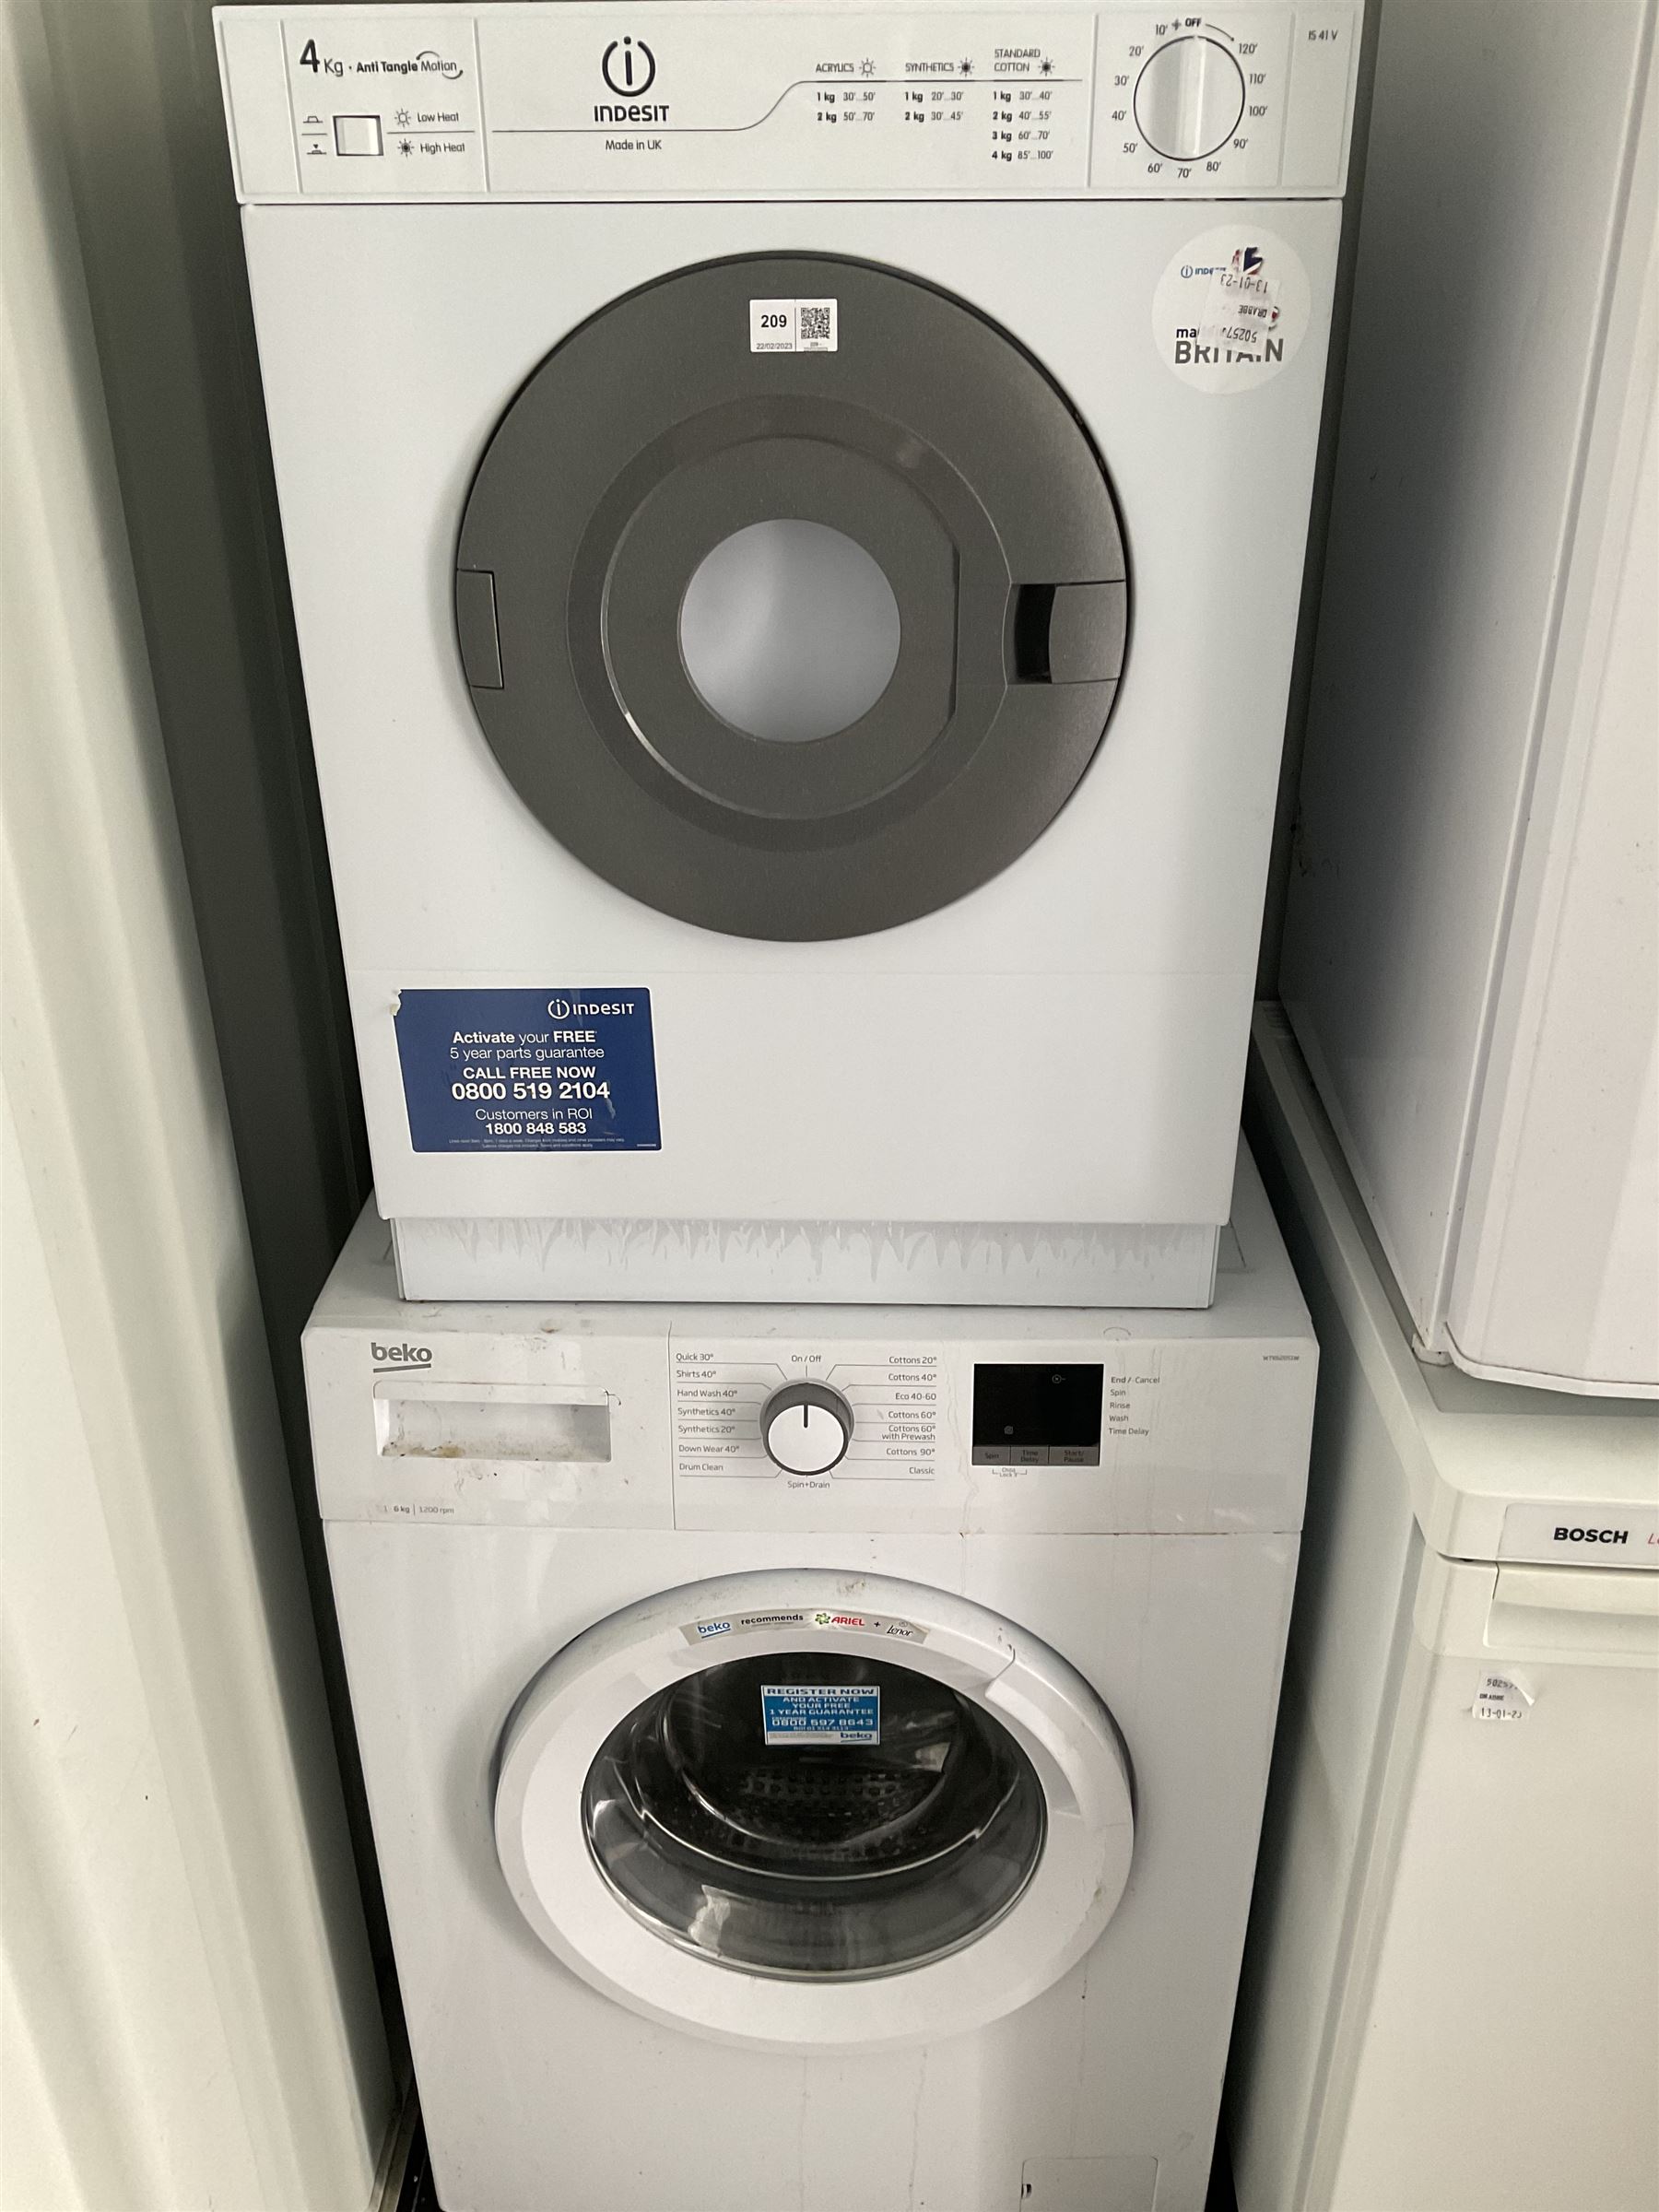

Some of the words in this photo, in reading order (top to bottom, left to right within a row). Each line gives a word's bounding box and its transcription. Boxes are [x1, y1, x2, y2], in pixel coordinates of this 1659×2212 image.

[1185, 18, 1202, 28] OFF
[300, 39, 320, 73] 4
[324, 58, 343, 77] Kg
[357, 62, 378, 73] Anti
[382, 61, 418, 75] Tangle
[420, 61, 457, 72] Motion
[994, 49, 1041, 58] STANDARD
[816, 63, 854, 73] ACRYLICS
[905, 63, 955, 73] SYNTHETICS
[994, 62, 1030, 72] COTTON
[824, 91, 835, 103] kg
[912, 91, 924, 103] kg
[1000, 91, 1011, 102] kg
[418, 112, 436, 123] Low
[438, 112, 459, 122] Heat
[594, 104, 669, 123] INDESIT
[826, 112, 837, 123] kg
[912, 112, 924, 123] kg
[1000, 111, 1012, 123] kg
[1001, 131, 1012, 142] kg
[420, 143, 441, 155] High
[443, 143, 465, 152] Heat
[606, 139, 633, 151] Made
[636, 139, 645, 150] in
[647, 139, 663, 150] UK
[1001, 150, 1012, 162] kg
[760, 314, 787, 328] 209
[1222, 327, 1258, 343] 50257
[572, 1003, 634, 1015] INDESIT
[453, 1030, 515, 1044] Activate
[518, 1033, 549, 1046] your
[450, 1047, 459, 1059] 5
[463, 1049, 494, 1062] year
[497, 1047, 532, 1062] parts
[535, 1047, 605, 1061] guarantee
[463, 1066, 506, 1080] CALL
[510, 1066, 552, 1079] FREE
[556, 1066, 596, 1079] NOW
[452, 1082, 507, 1100] 0800
[513, 1082, 552, 1100] 519
[559, 1082, 610, 1100] 2104
[476, 1108, 548, 1121] Customers
[552, 1108, 563, 1120] in
[567, 1108, 593, 1120] ROI
[486, 1123, 523, 1135] 1800
[526, 1123, 554, 1135] 848
[559, 1123, 587, 1134] 583
[371, 1342, 432, 1363] beko
[677, 1353, 698, 1361] Quick
[889, 1356, 921, 1364] Cottons
[677, 1370, 700, 1378] Shirts
[677, 1407, 719, 1416] Synthetics
[678, 1426, 719, 1434] Synthetics
[1128, 1428, 1148, 1436] Delay
[678, 1444, 701, 1453] Down
[703, 1444, 723, 1453] Wear
[401, 1505, 410, 1513] kg
[1554, 1527, 1629, 1544] BOSCH
[698, 1621, 731, 1634] beko
[741, 1614, 804, 1625] recommends
[831, 1617, 865, 1627] ARIEL
[887, 1625, 913, 1637] Lenor
